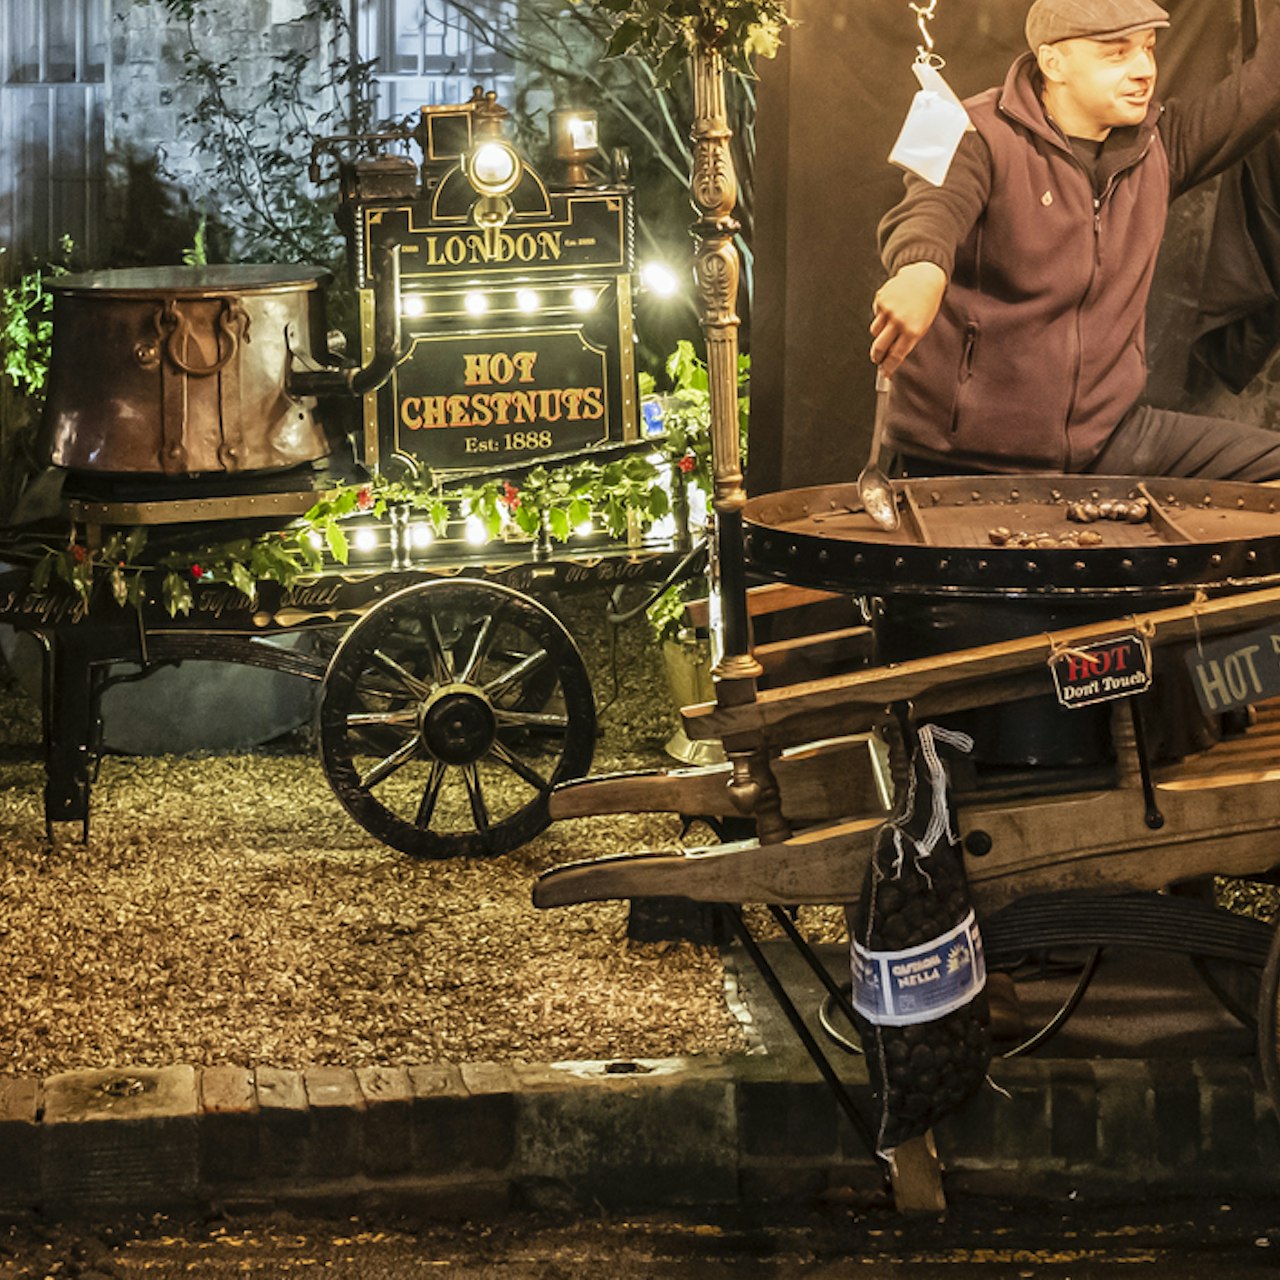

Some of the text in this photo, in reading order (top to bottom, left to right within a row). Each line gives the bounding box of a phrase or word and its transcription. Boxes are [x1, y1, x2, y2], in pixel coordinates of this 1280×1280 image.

[426, 231, 562, 266] LONDON
[463, 351, 538, 386] HOT
[401, 387, 605, 430] CHESTNUTS
[505, 430, 553, 451] 1888
[1068, 645, 1131, 682] HOT
[1195, 644, 1263, 710] HOT
[1063, 671, 1146, 700] Don't Touch
